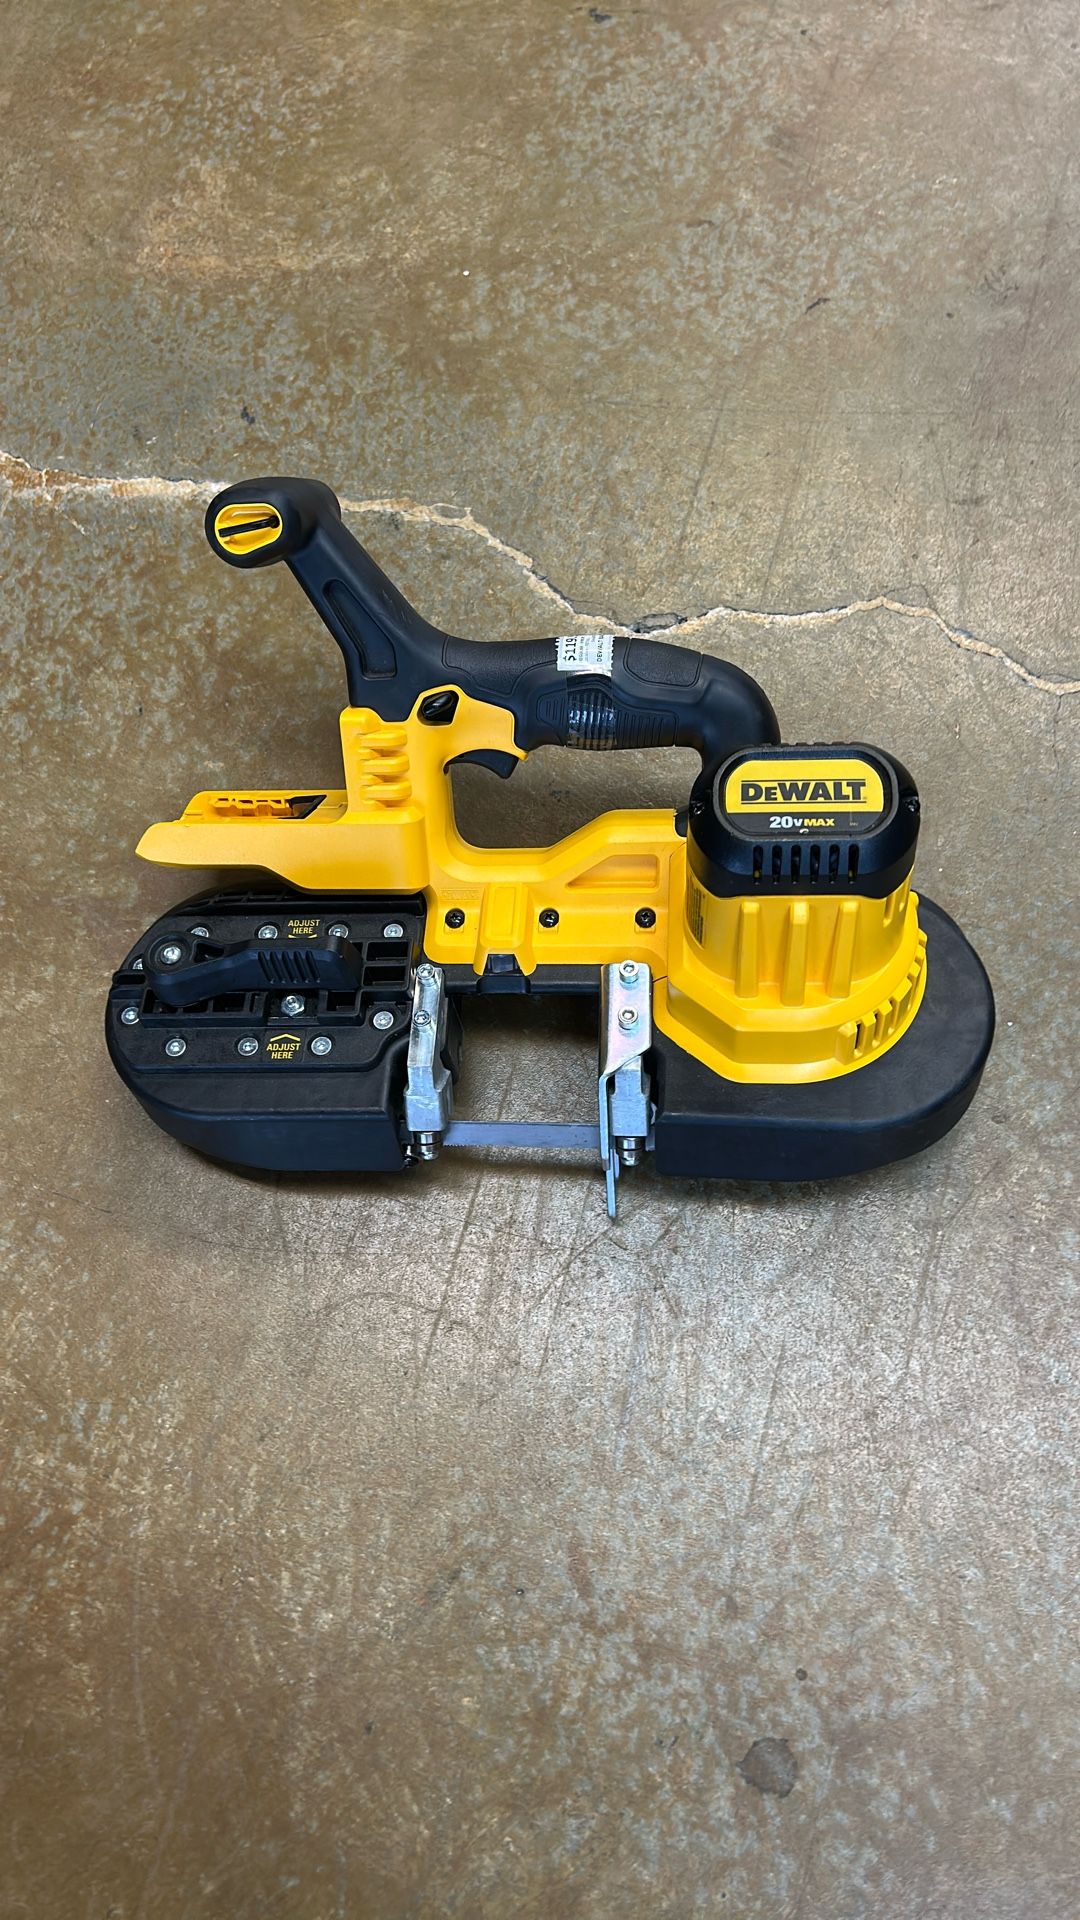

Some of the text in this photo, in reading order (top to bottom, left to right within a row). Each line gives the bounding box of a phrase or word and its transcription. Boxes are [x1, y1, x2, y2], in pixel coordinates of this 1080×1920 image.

[740, 781, 866, 802] DEWALT
[803, 818, 835, 827] MAX
[287, 919, 321, 927] ADJUST
[292, 927, 314, 935] HERE
[266, 1043, 302, 1051] ADJUST
[271, 1051, 294, 1060] HERE
